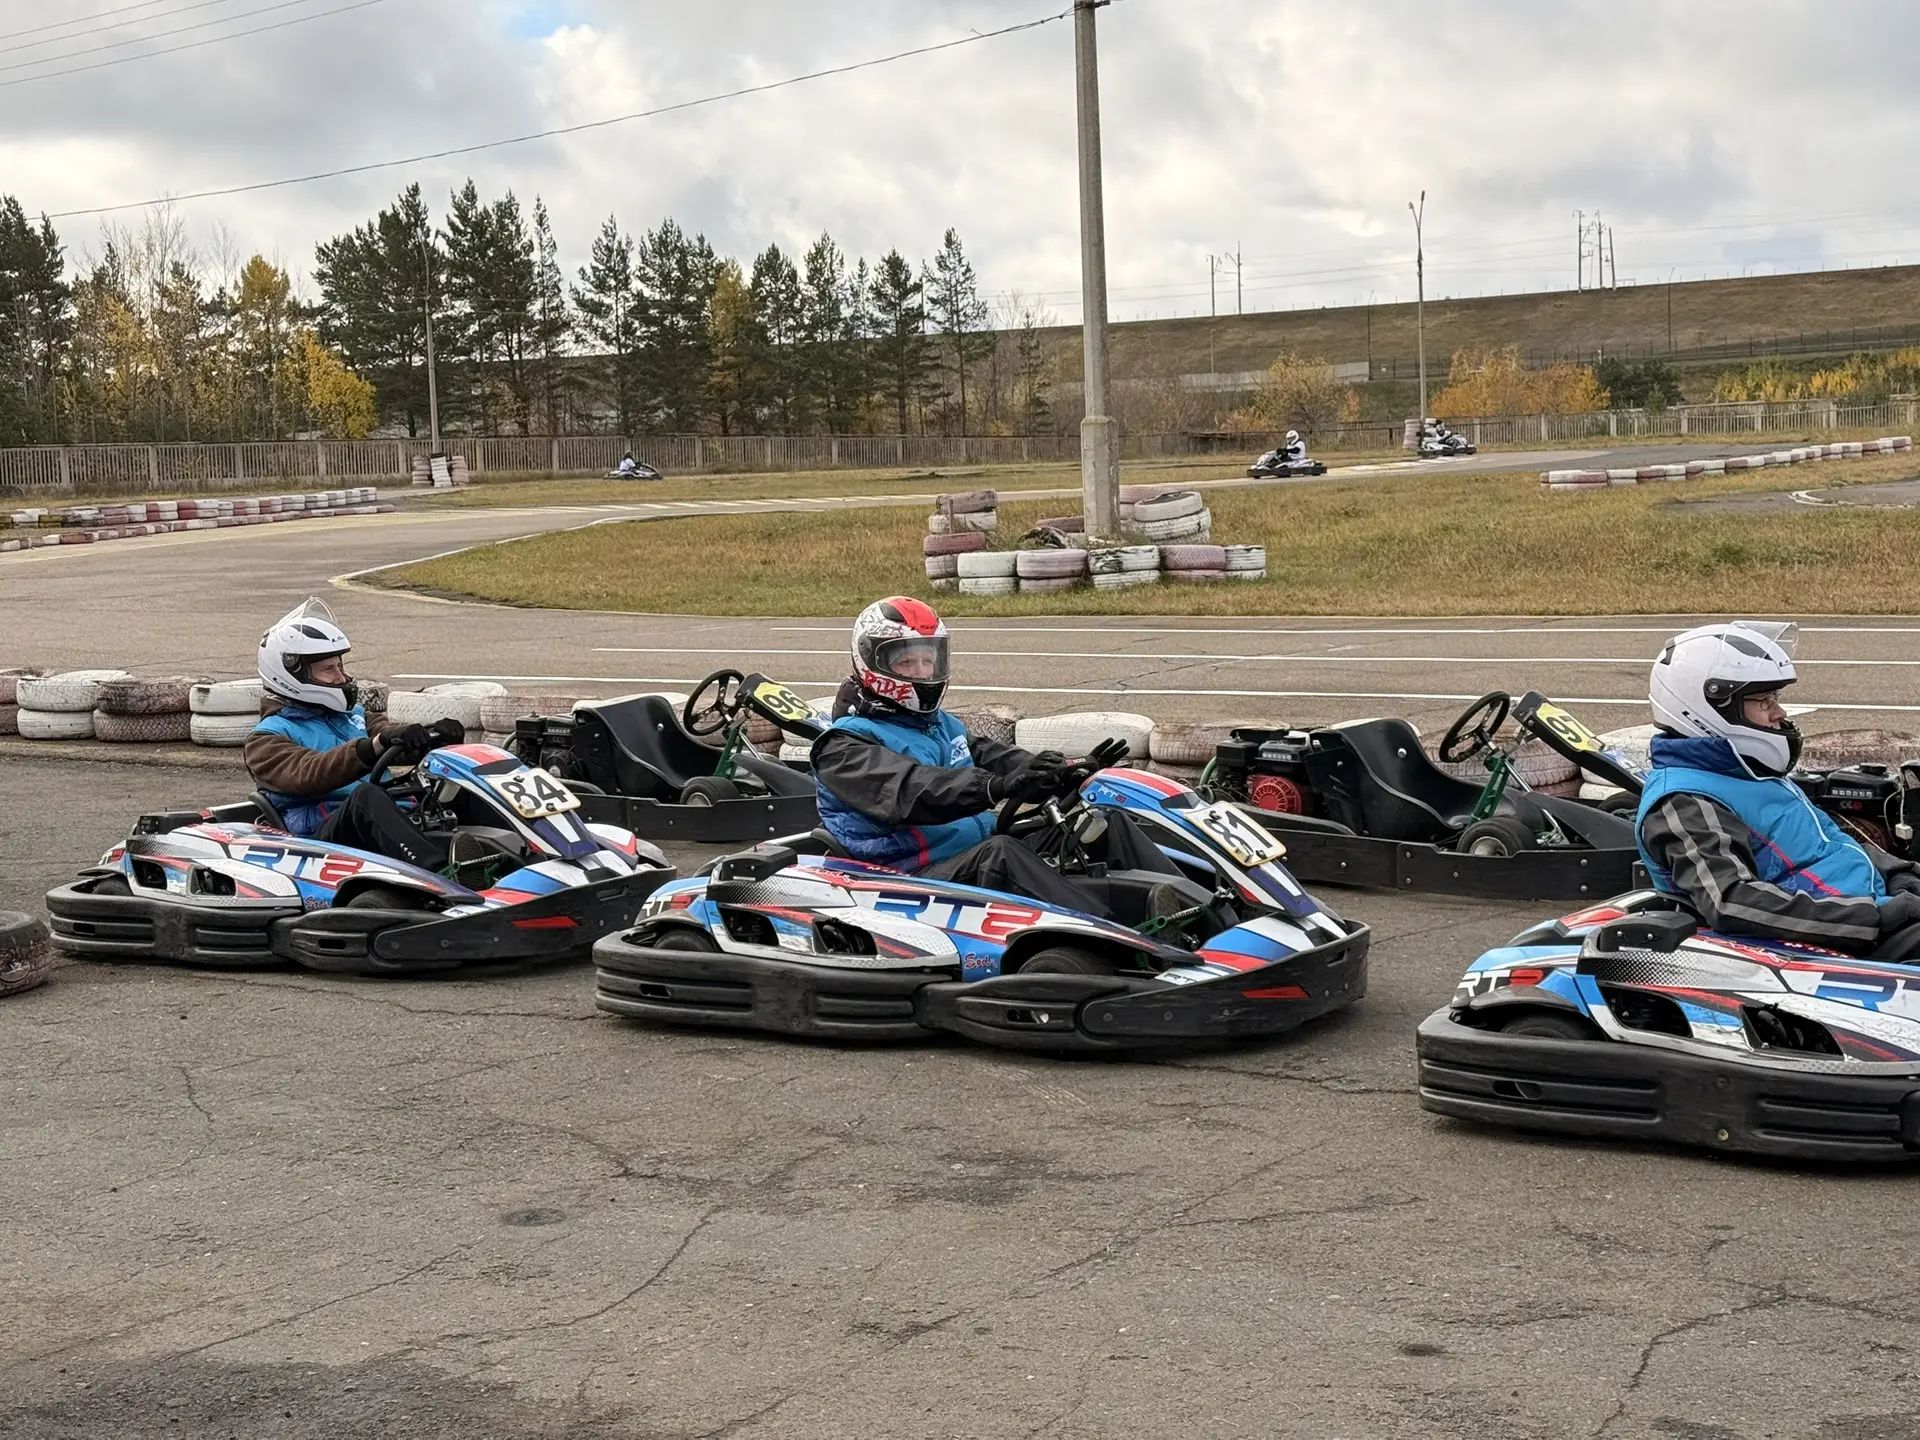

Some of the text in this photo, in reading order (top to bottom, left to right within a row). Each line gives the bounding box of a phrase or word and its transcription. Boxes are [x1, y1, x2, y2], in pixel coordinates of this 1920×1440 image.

[763, 690, 810, 715] 96
[1546, 715, 1594, 743] 97
[501, 775, 569, 811] 84
[1204, 810, 1273, 857] 81
